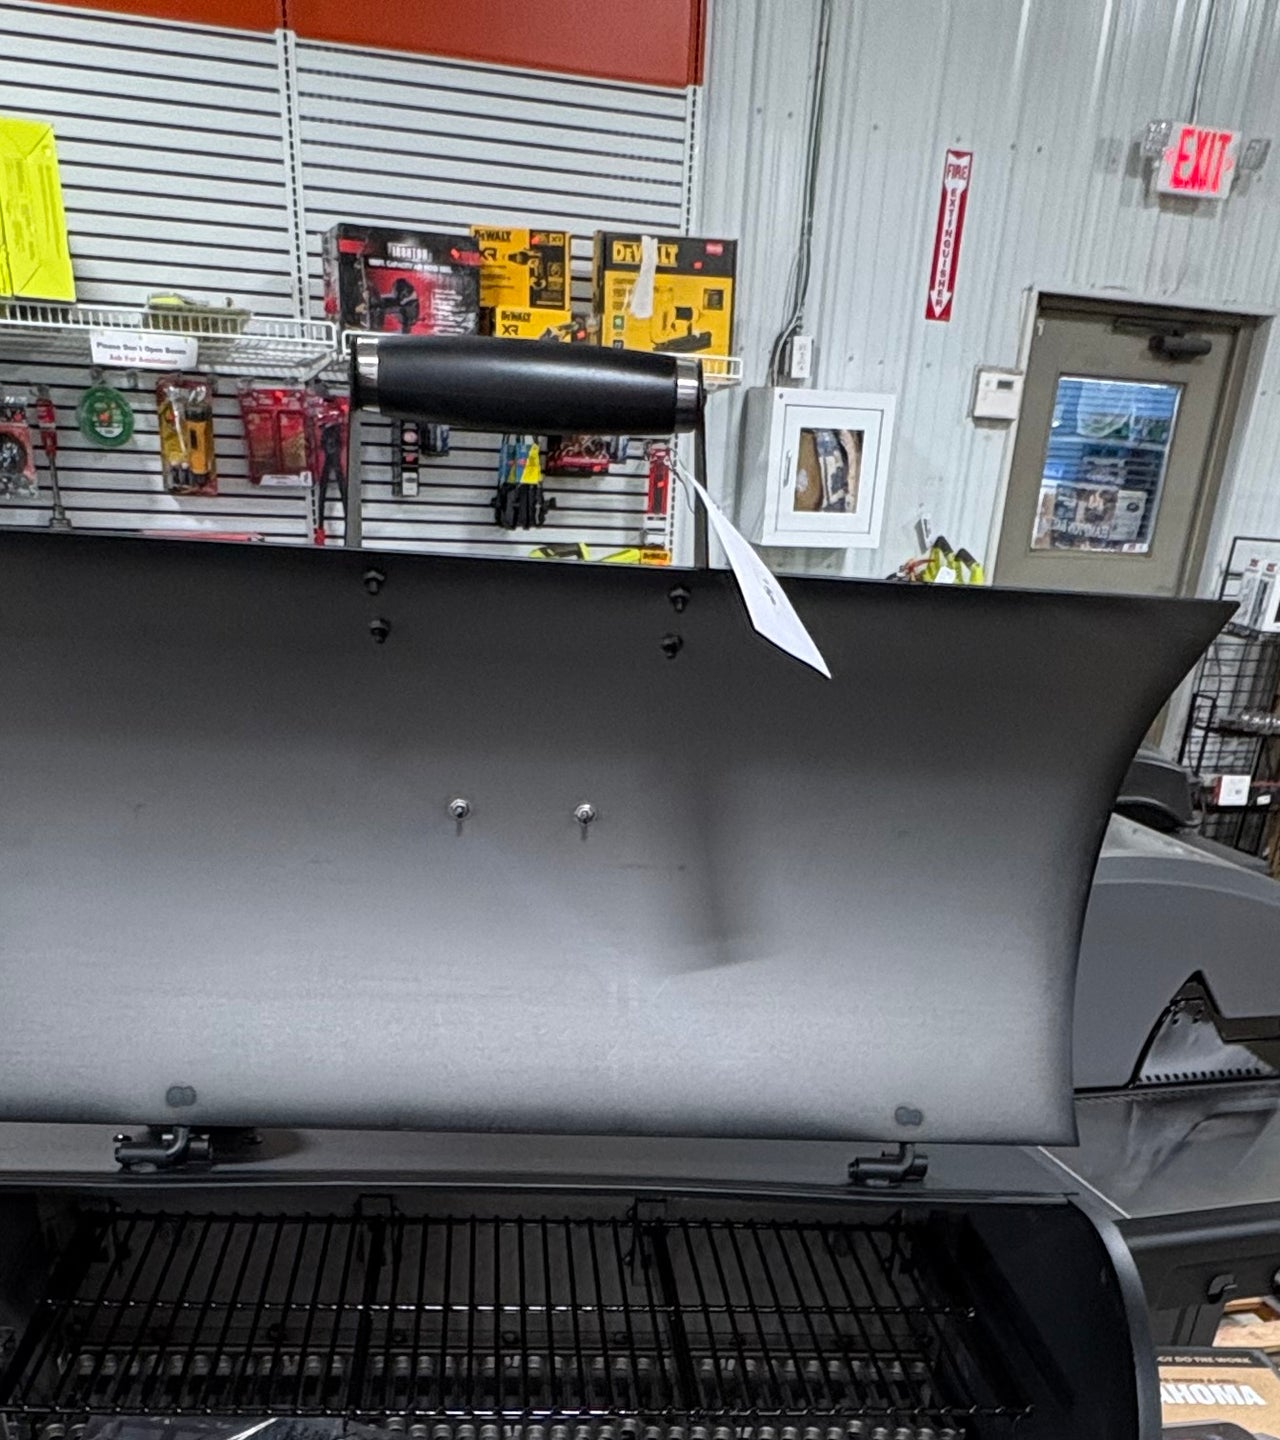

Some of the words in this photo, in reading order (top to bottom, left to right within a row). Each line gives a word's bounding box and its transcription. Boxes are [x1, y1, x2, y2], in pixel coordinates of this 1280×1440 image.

[947, 163, 968, 180] FIRE
[1170, 128, 1232, 193] EXIT
[612, 241, 678, 267] DEWLT
[935, 188, 957, 308] EXTINGUISHER
[502, 324, 519, 336] XR
[96, 342, 121, 350] Please
[145, 346, 164, 354] Open
[1160, 1383, 1267, 1405] AHOMA
